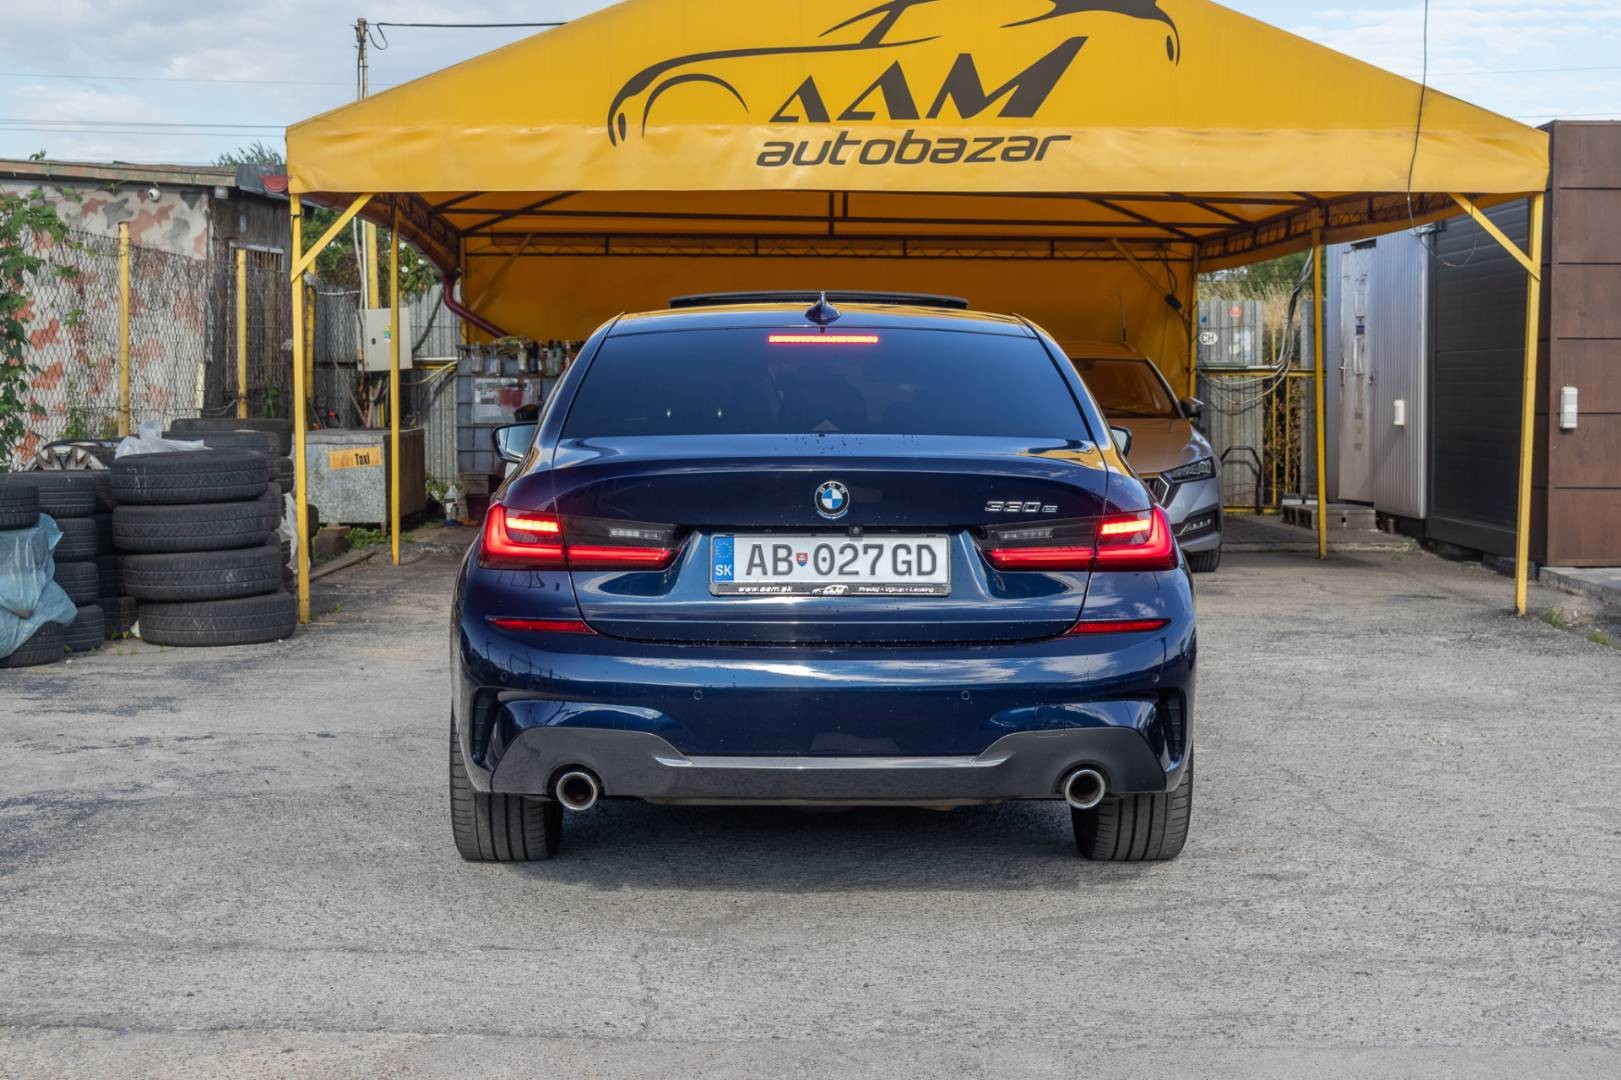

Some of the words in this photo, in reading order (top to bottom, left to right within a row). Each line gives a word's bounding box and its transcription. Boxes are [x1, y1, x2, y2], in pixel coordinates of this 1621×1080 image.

[768, 36, 1089, 123] AAM
[756, 129, 1072, 167] autobazar
[354, 452, 371, 466] Taxi
[984, 500, 1058, 513] 330e
[715, 565, 732, 576] SK
[745, 543, 794, 577] AB
